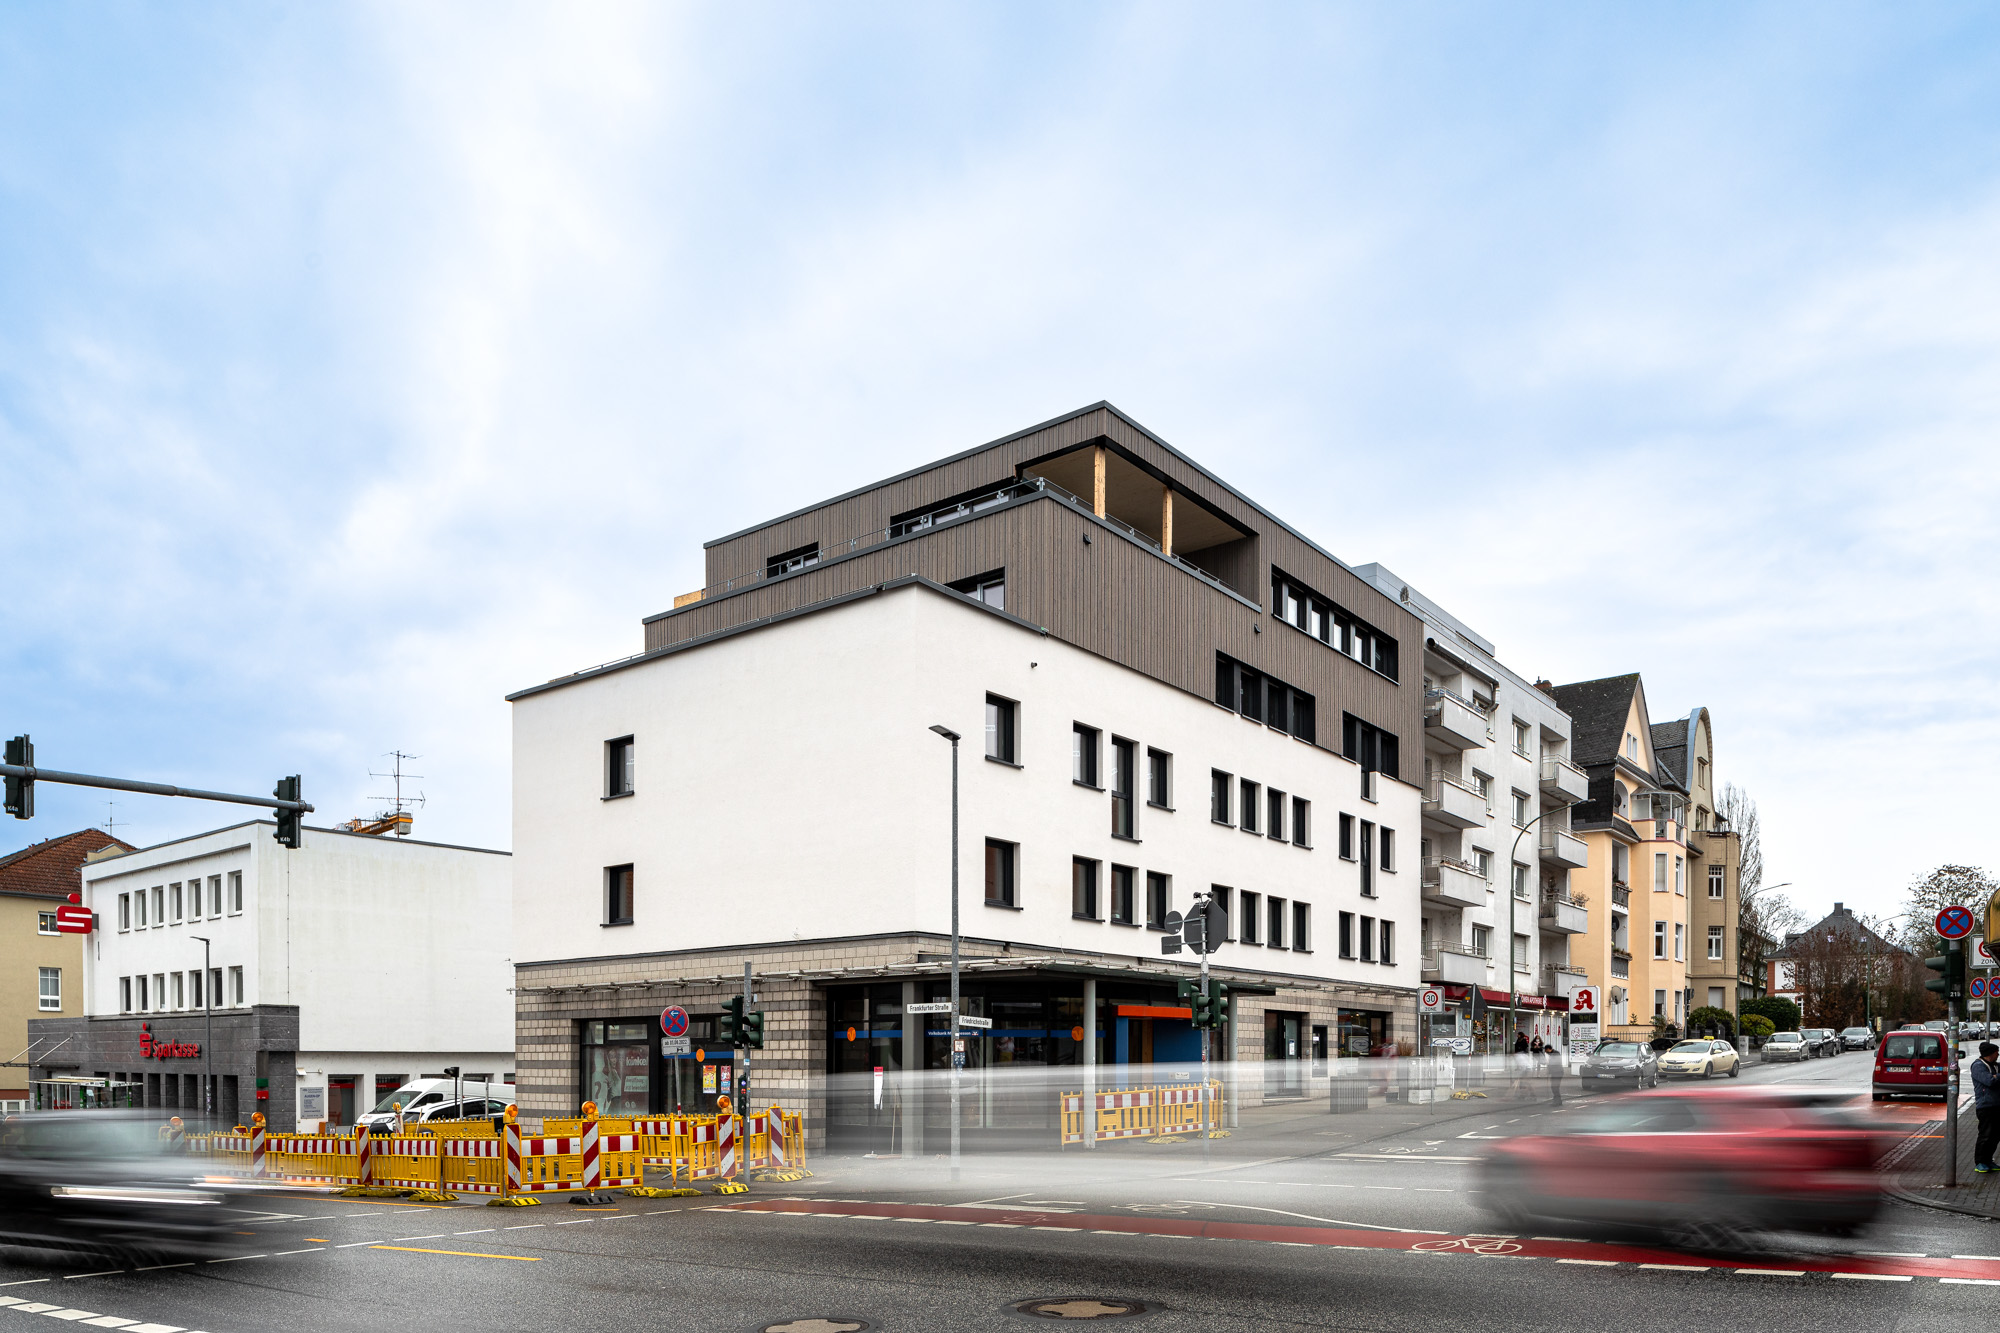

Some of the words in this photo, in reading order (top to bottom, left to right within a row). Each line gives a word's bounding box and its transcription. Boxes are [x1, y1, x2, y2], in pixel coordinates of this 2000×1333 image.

[1426, 994, 1436, 1003] 30
[934, 1003, 949, 1011] Straße
[961, 1016, 989, 1026] Friedrichstraße
[152, 1038, 199, 1061] Sparkasse
